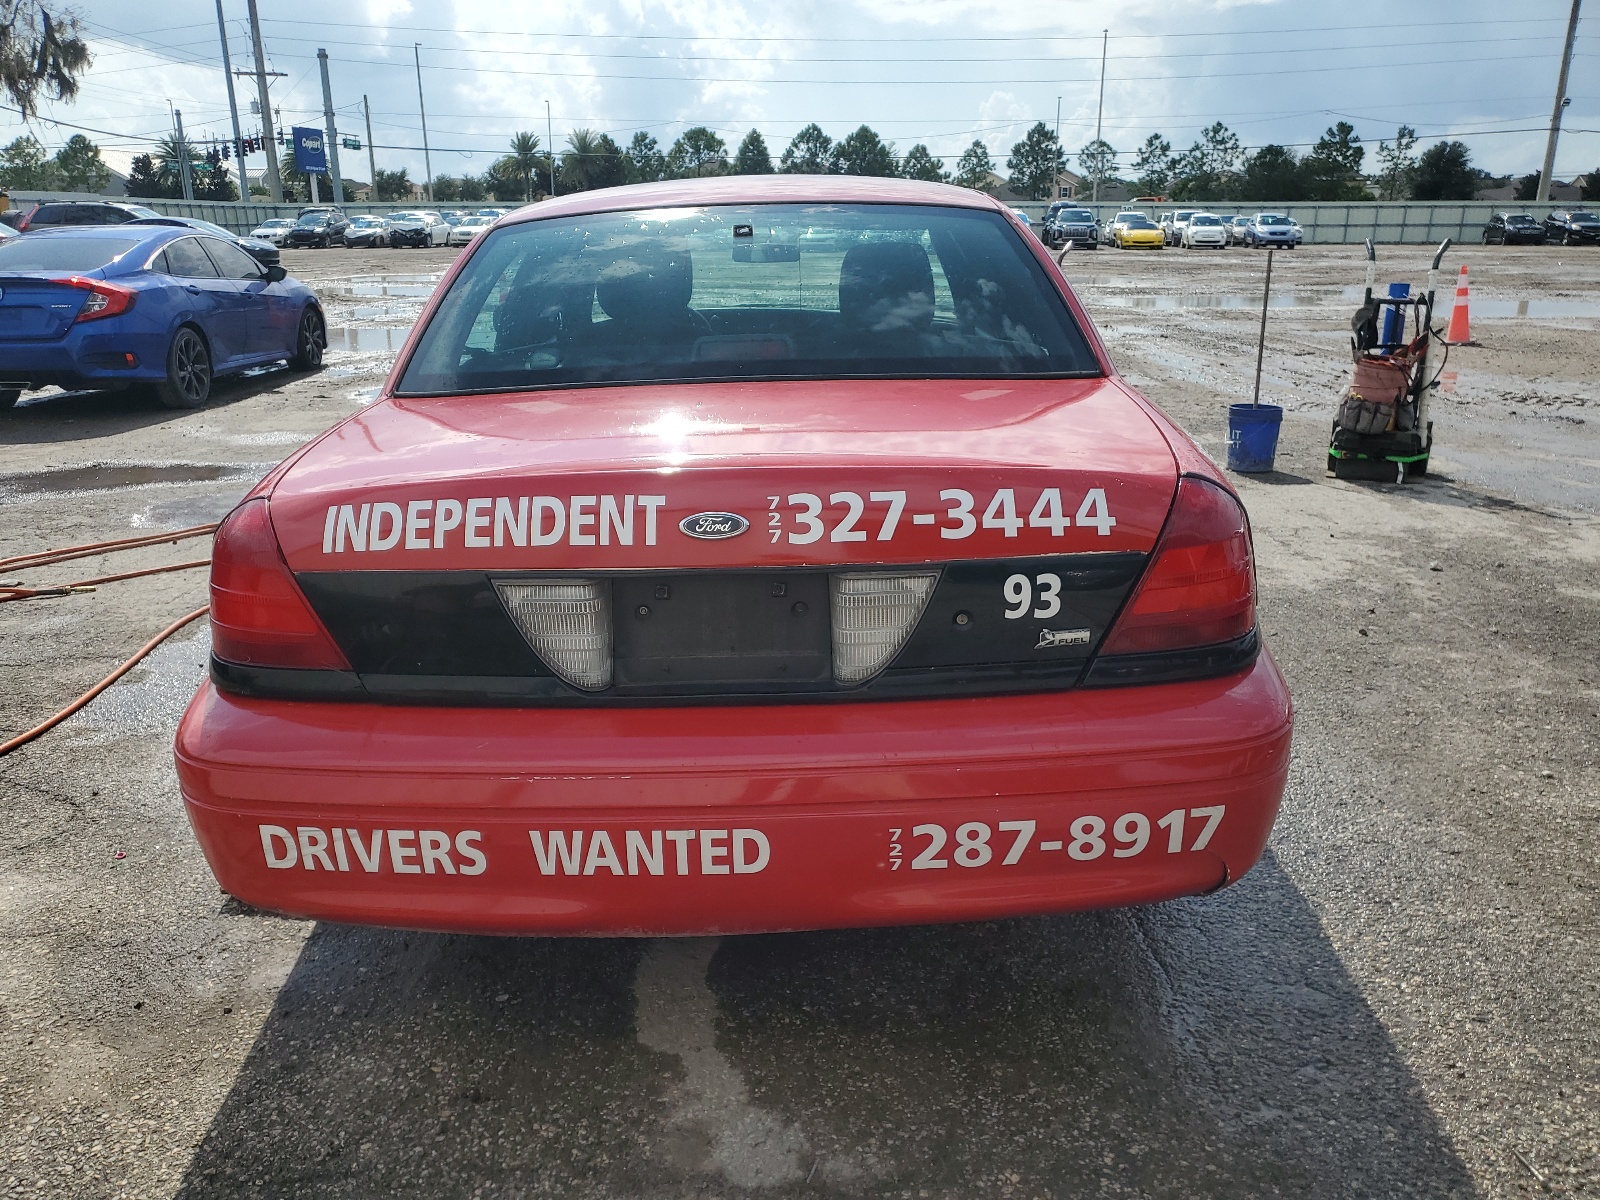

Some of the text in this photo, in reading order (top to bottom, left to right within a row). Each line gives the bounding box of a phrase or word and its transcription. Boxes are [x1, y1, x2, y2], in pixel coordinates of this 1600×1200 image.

[302, 137, 320, 150] Copart
[322, 494, 667, 554] INDEPENDENT
[695, 517, 732, 532] Ford
[787, 488, 1117, 545] 327-3444
[1003, 573, 1062, 619] 93
[1058, 637, 1087, 645] FUEL
[259, 824, 771, 876] DRIVERS WANTED
[911, 804, 1226, 870] 287-8917
